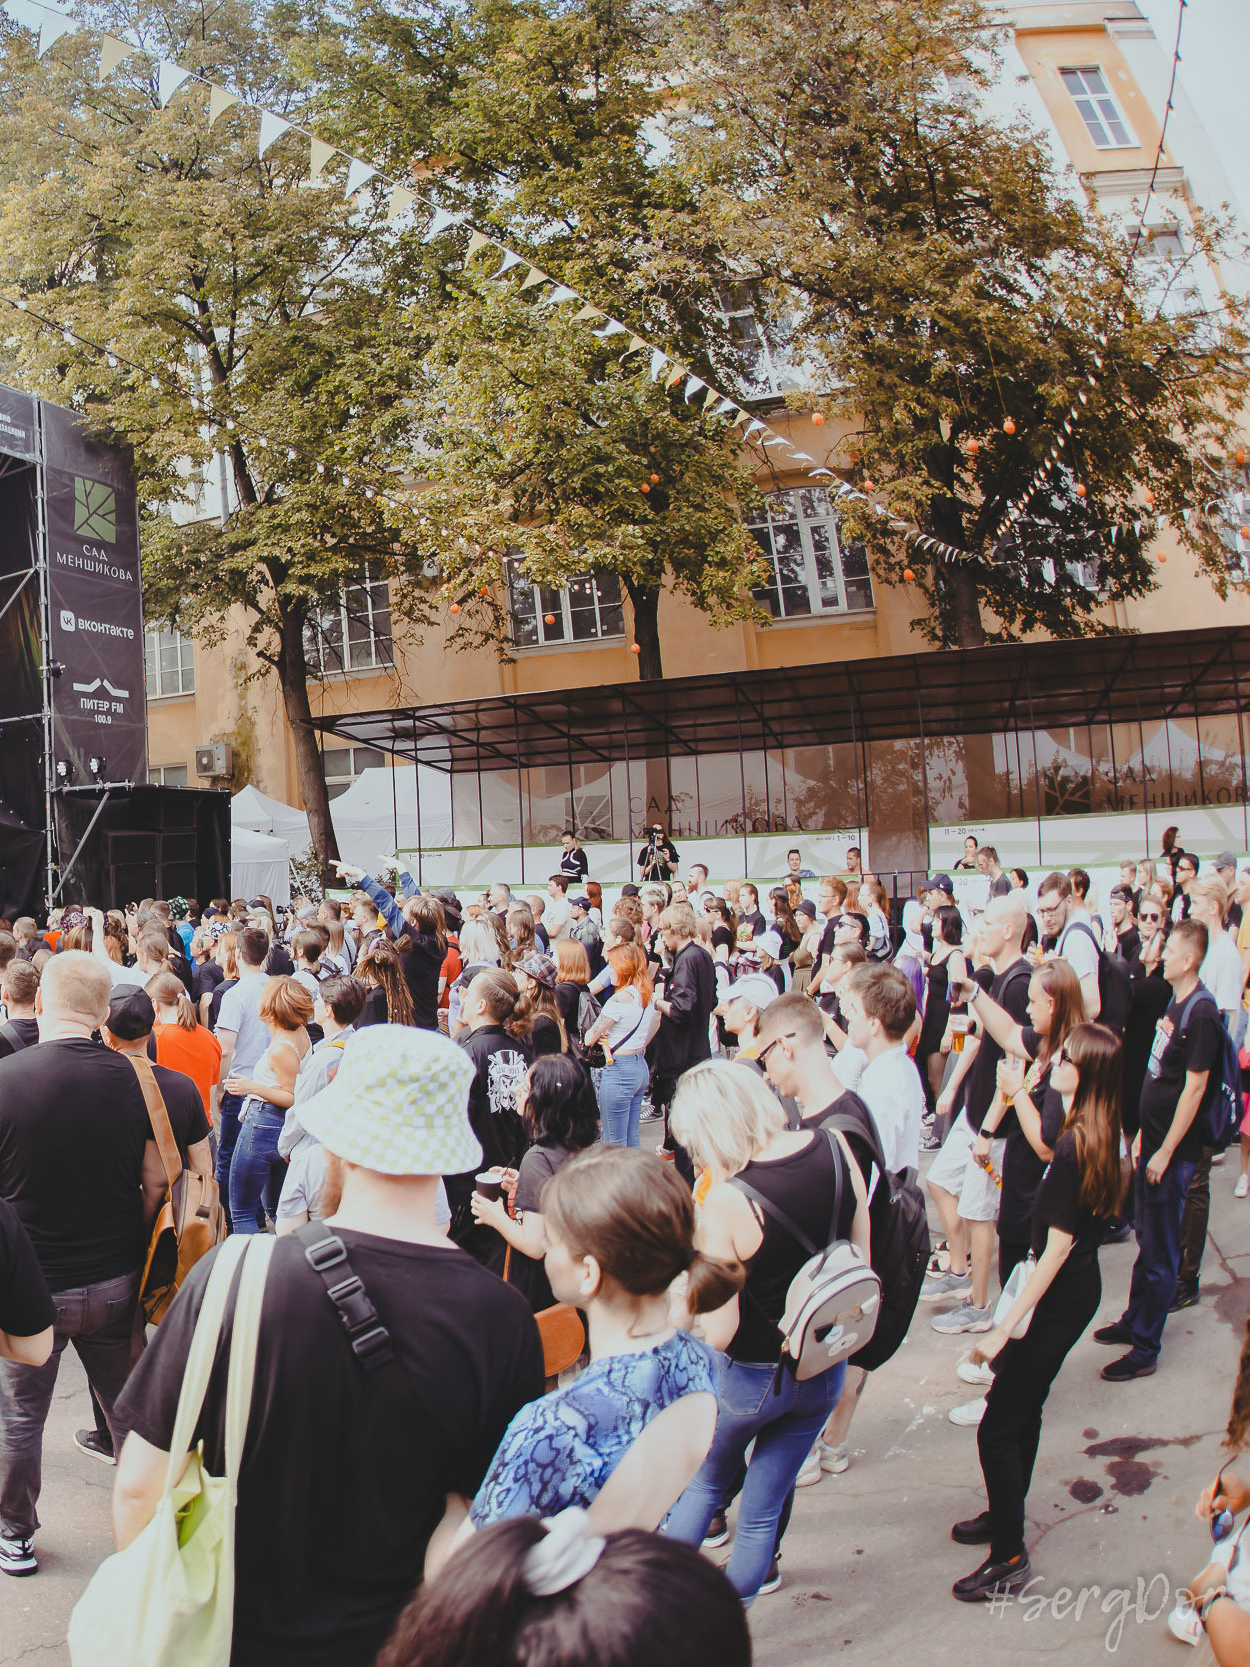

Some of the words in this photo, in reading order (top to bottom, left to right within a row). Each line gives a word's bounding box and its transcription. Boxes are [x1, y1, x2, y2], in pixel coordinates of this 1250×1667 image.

[82, 544, 109, 562] САД
[56, 551, 134, 582] МЕНШИКОВА
[80, 697, 110, 712] ПИТЕР
[111, 701, 124, 714] FM
[94, 713, 112, 725] 100.9
[630, 796, 682, 815] САД
